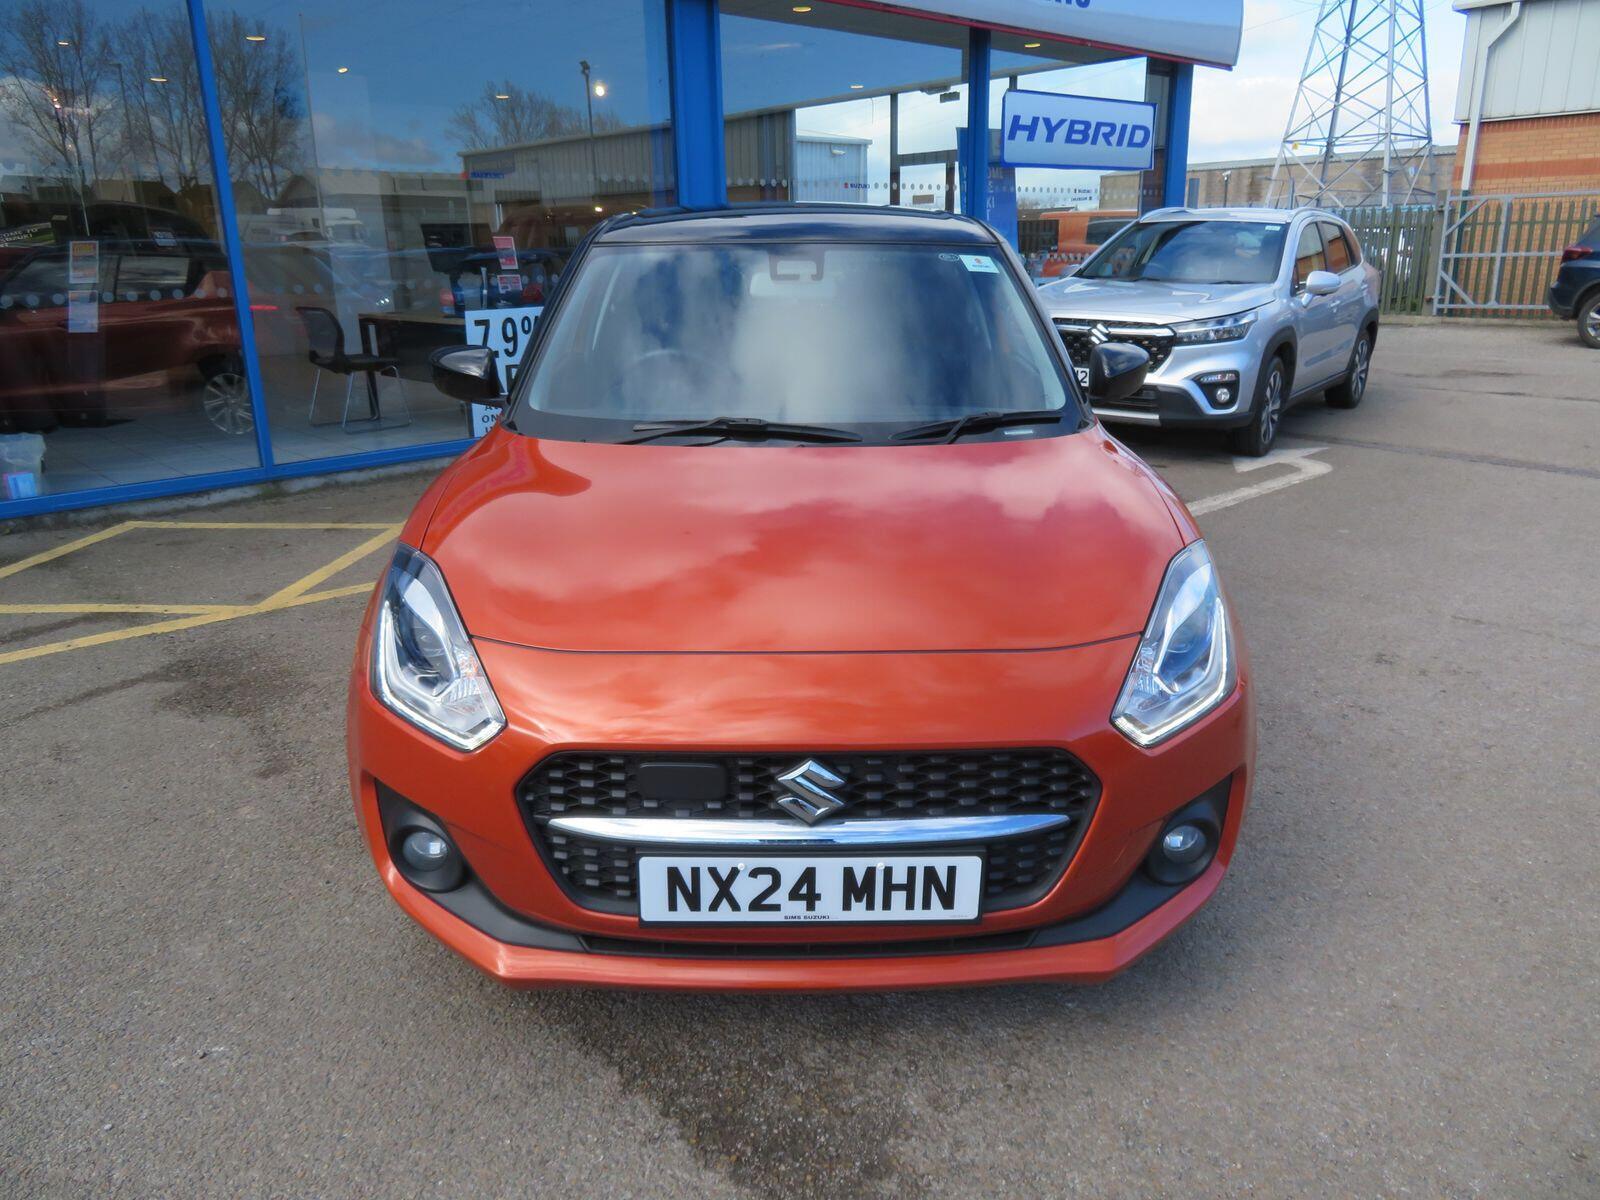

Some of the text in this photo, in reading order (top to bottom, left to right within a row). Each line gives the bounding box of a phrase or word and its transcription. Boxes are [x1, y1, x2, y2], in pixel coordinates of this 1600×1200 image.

[1007, 115, 1153, 149] HYBRID
[666, 865, 957, 913] NX24 MHN
